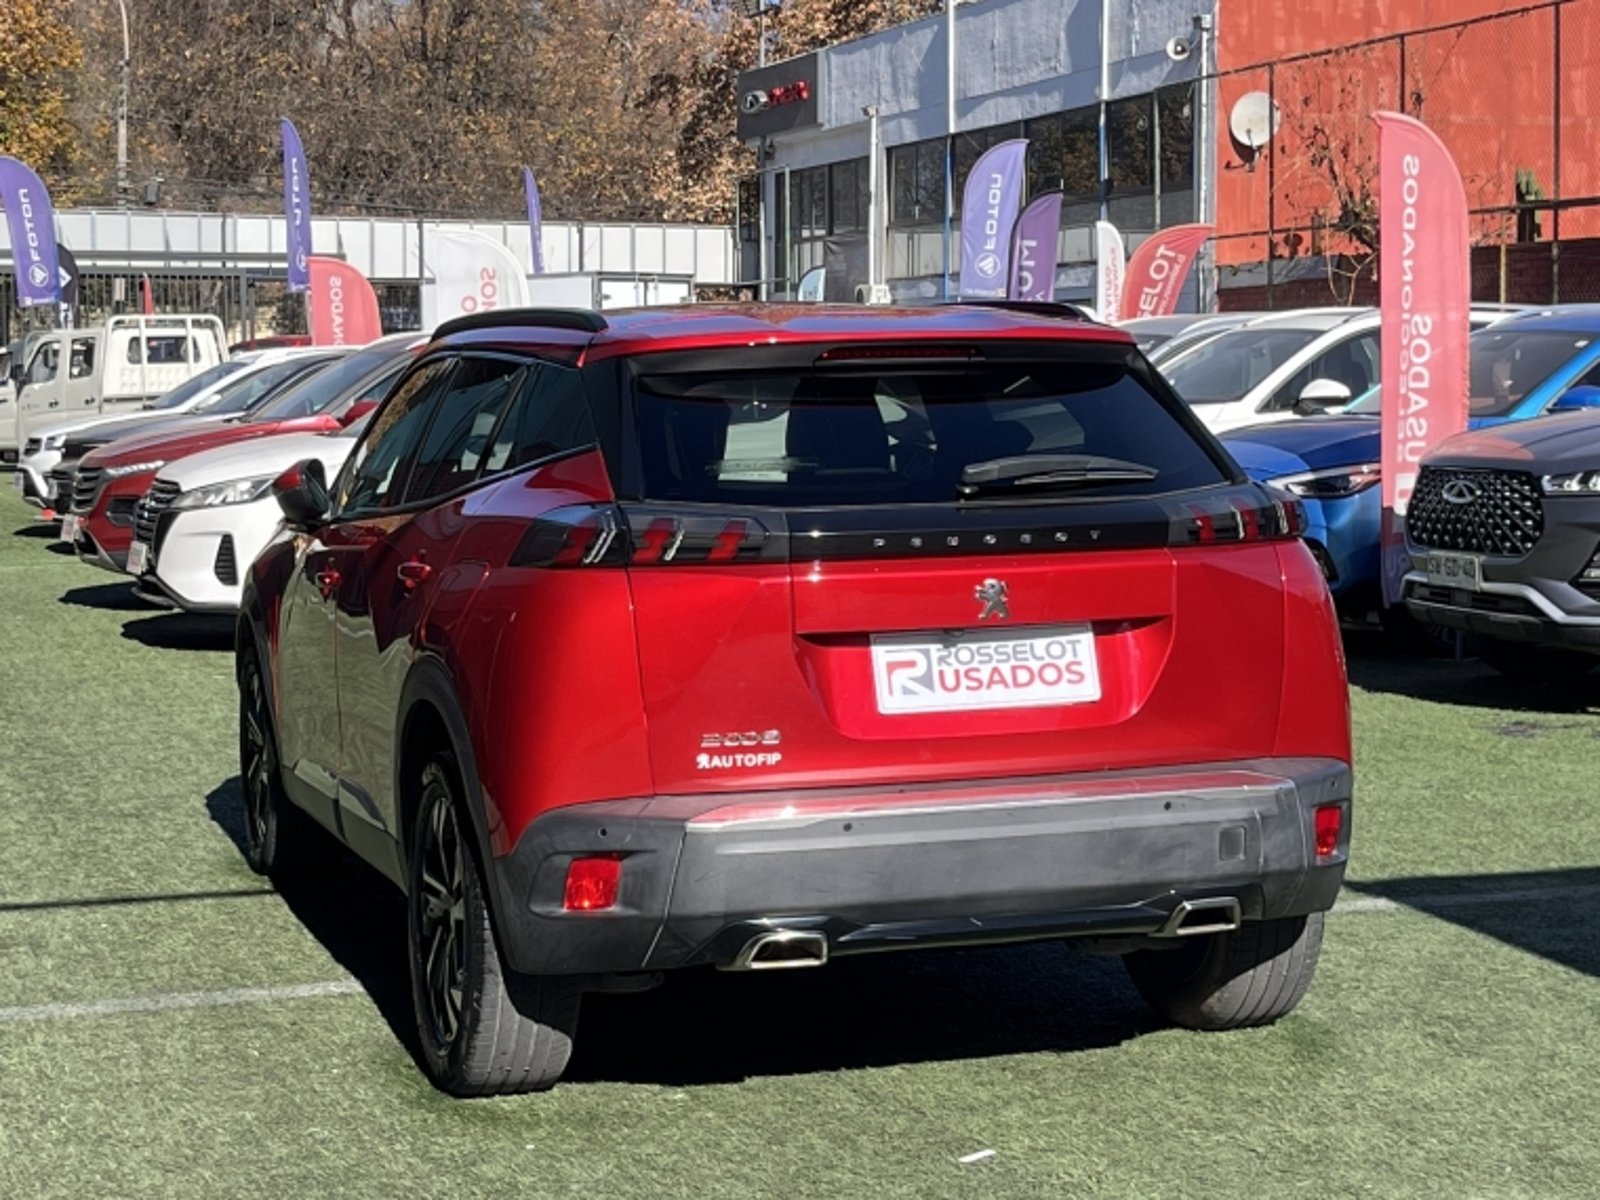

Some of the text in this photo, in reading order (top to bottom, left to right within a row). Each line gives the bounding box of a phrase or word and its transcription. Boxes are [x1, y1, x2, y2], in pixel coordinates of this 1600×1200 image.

[18, 188, 41, 261] FOTON
[936, 640, 1082, 667] ROSSELOT
[938, 661, 1086, 693] USADOS
[710, 752, 783, 769] AUTOFIP
